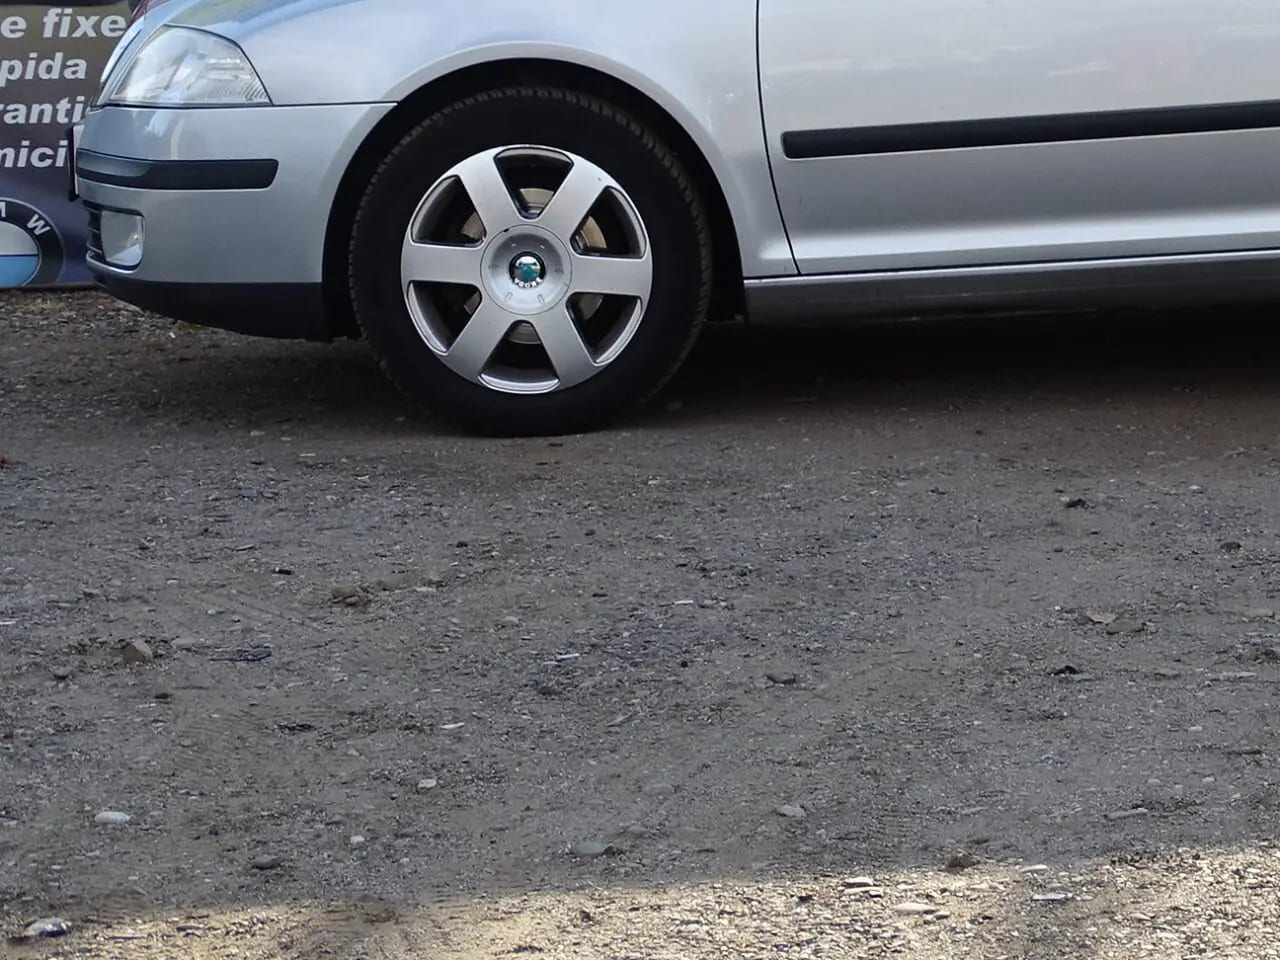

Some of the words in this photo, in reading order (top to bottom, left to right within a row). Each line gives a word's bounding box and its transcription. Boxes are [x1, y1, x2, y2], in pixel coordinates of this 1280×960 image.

[43, 8, 126, 38] fixe
[0, 52, 87, 87] pida
[0, 96, 85, 125] anti
